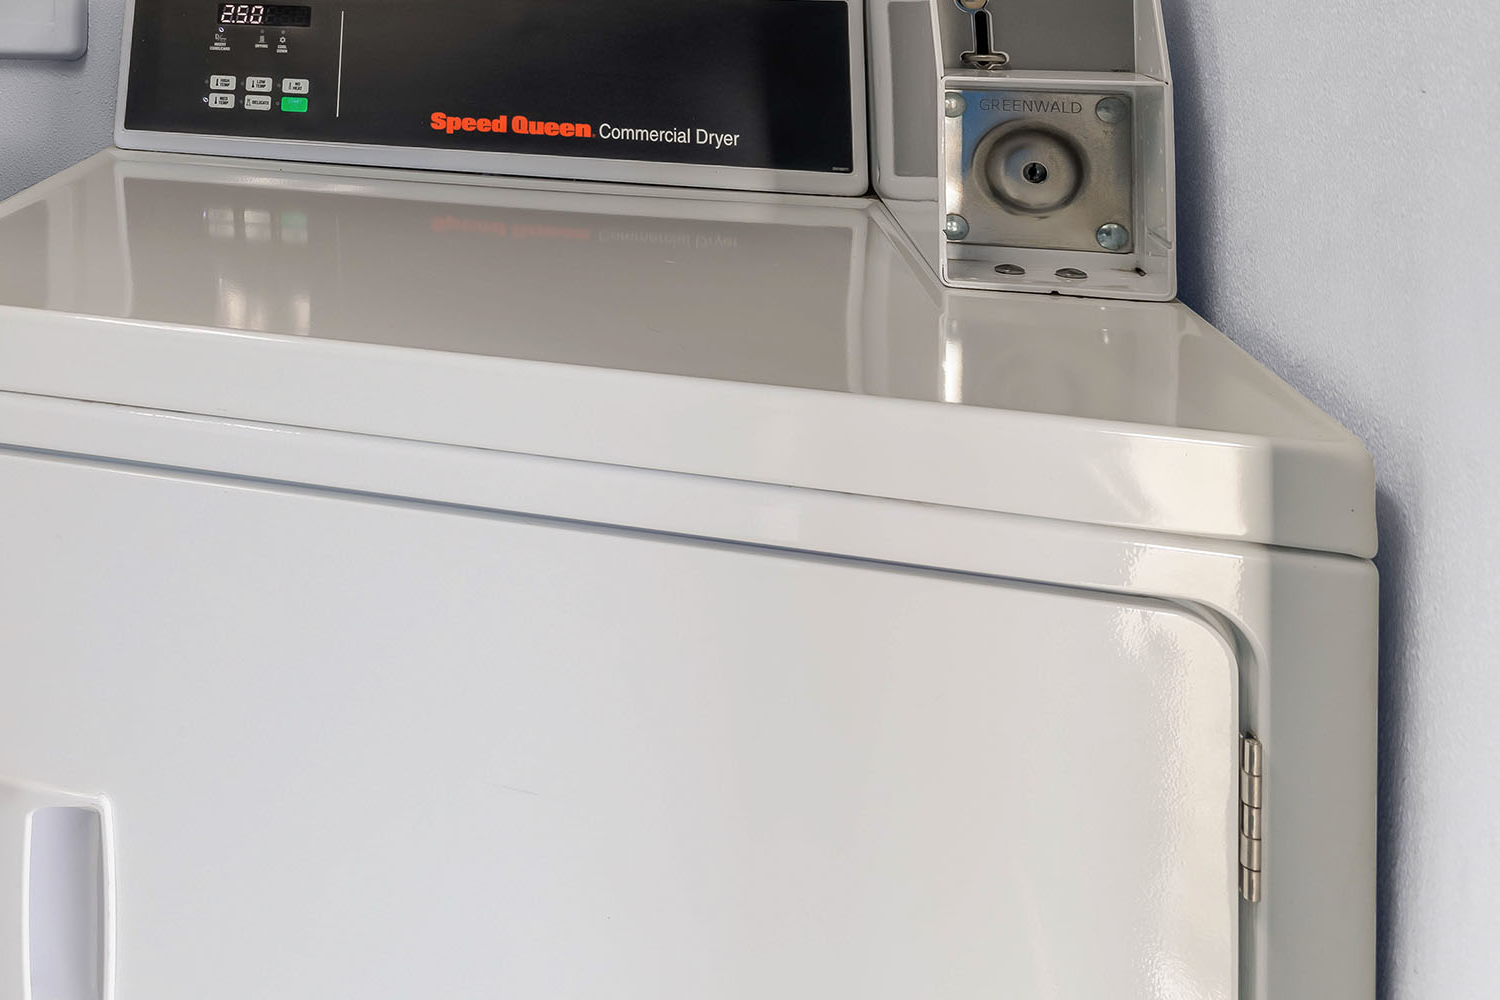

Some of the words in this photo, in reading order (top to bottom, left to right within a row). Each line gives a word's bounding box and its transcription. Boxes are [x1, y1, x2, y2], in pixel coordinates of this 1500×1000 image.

[220, 4, 264, 24] 2.50
[979, 98, 1083, 114] GREENWALD
[430, 112, 508, 135] Speed
[511, 115, 592, 138] Queen
[599, 123, 691, 144] Commercial
[696, 128, 740, 149] Dryer
